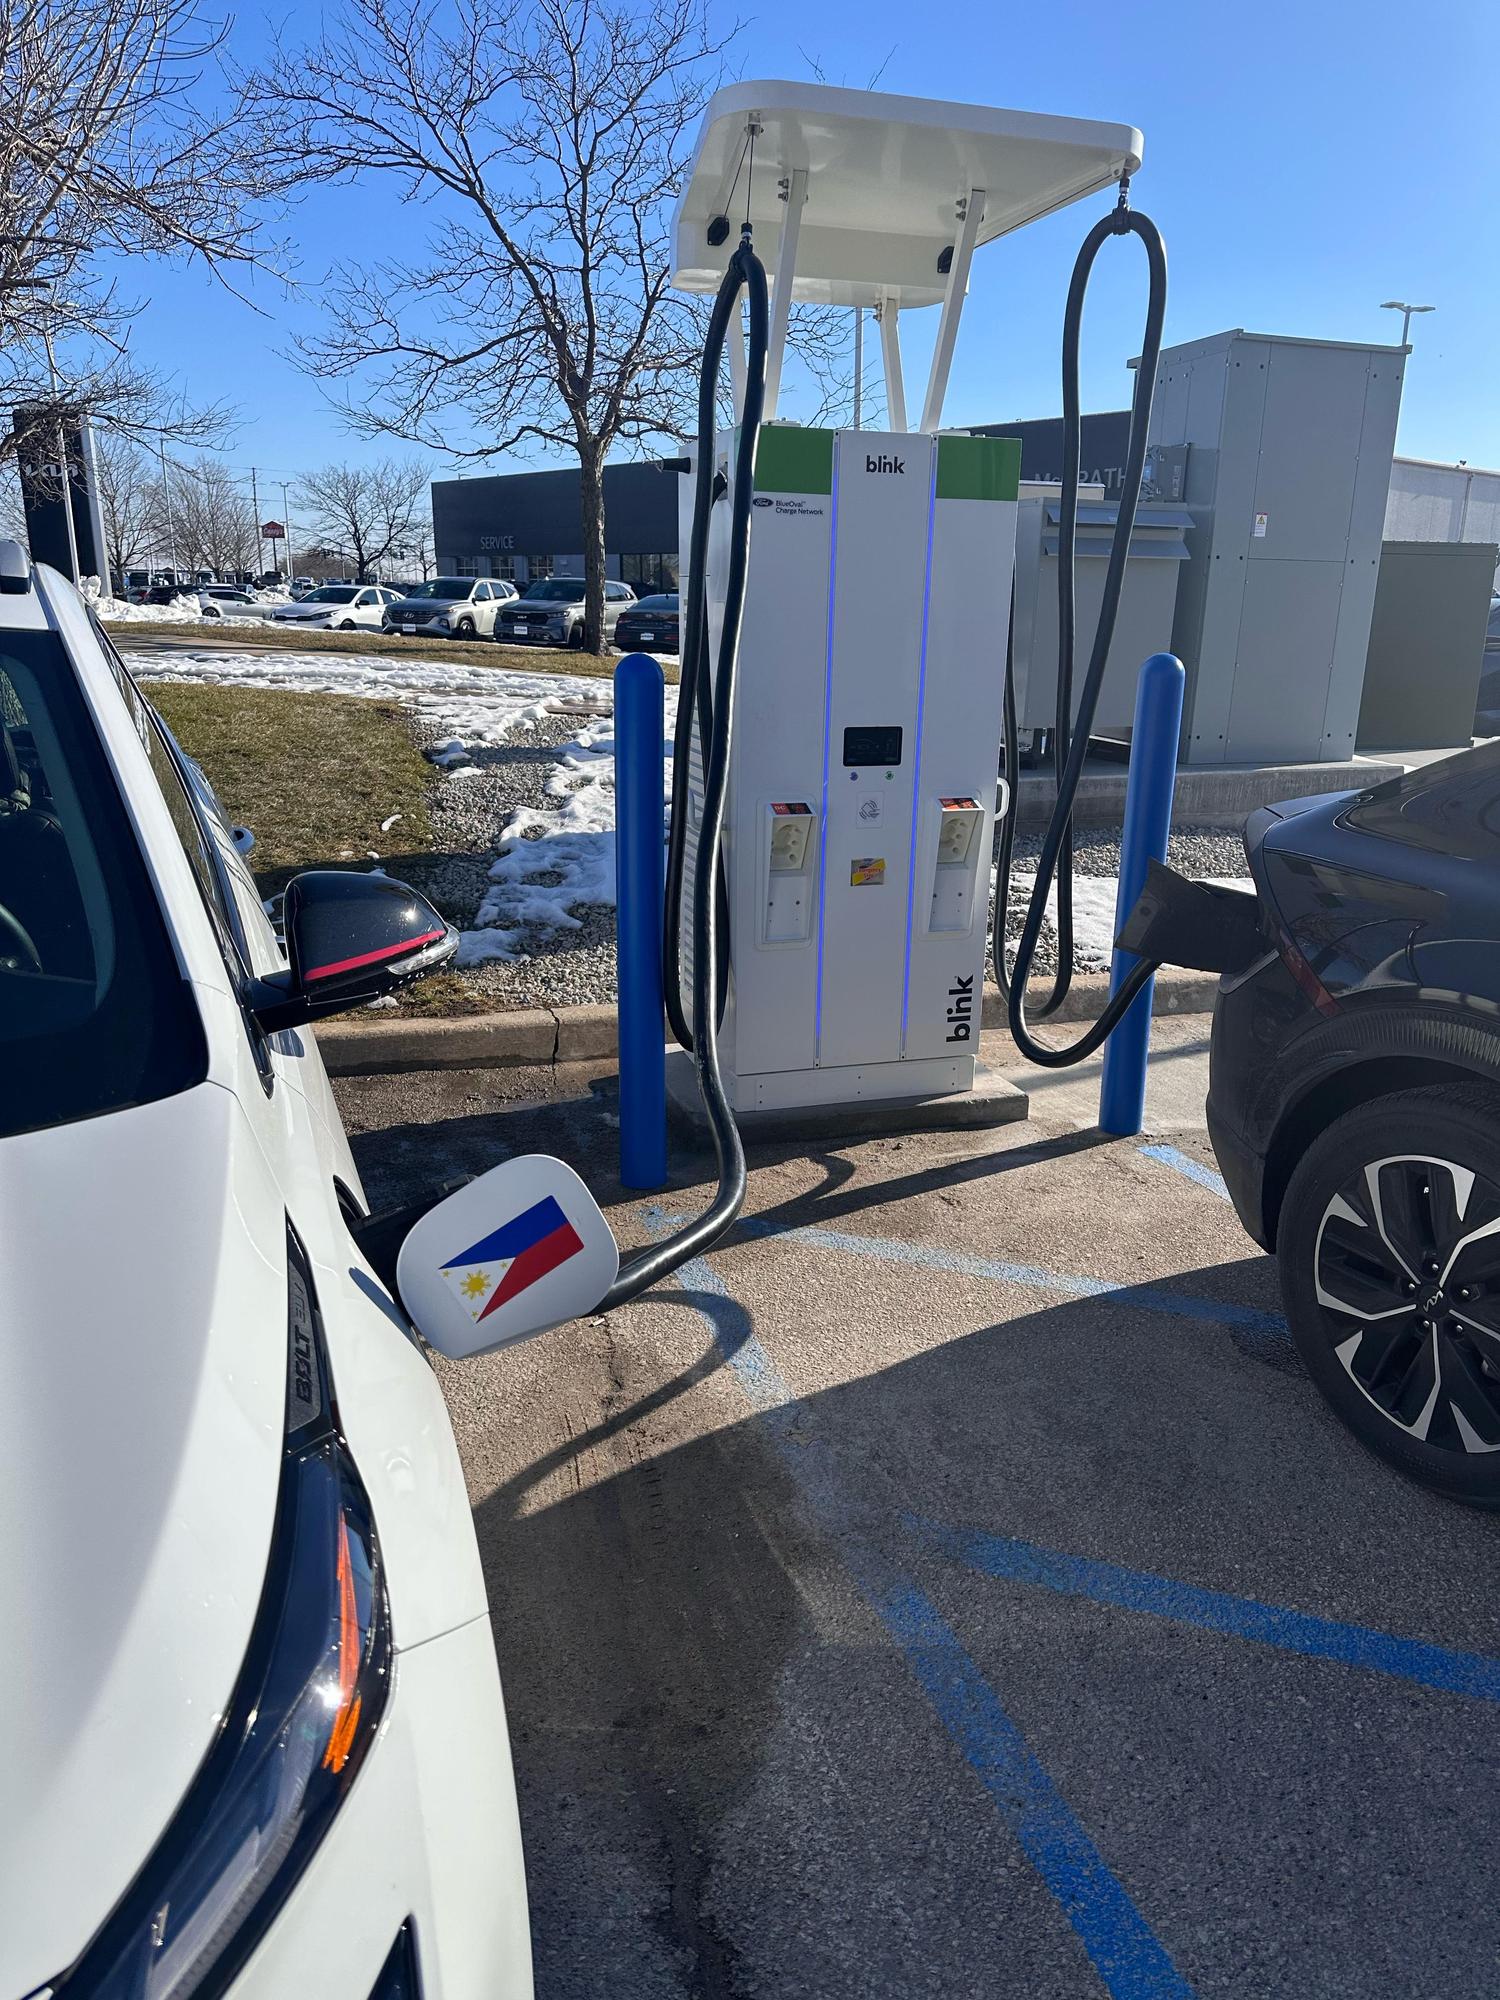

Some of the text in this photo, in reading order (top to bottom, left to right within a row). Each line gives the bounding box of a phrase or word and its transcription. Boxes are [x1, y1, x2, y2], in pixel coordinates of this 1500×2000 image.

[866, 455, 905, 474] blink
[775, 507, 797, 515] Charge
[480, 536, 514, 550] SERVICE
[946, 974, 974, 1042] blink
[294, 1324, 313, 1404] BOLT
